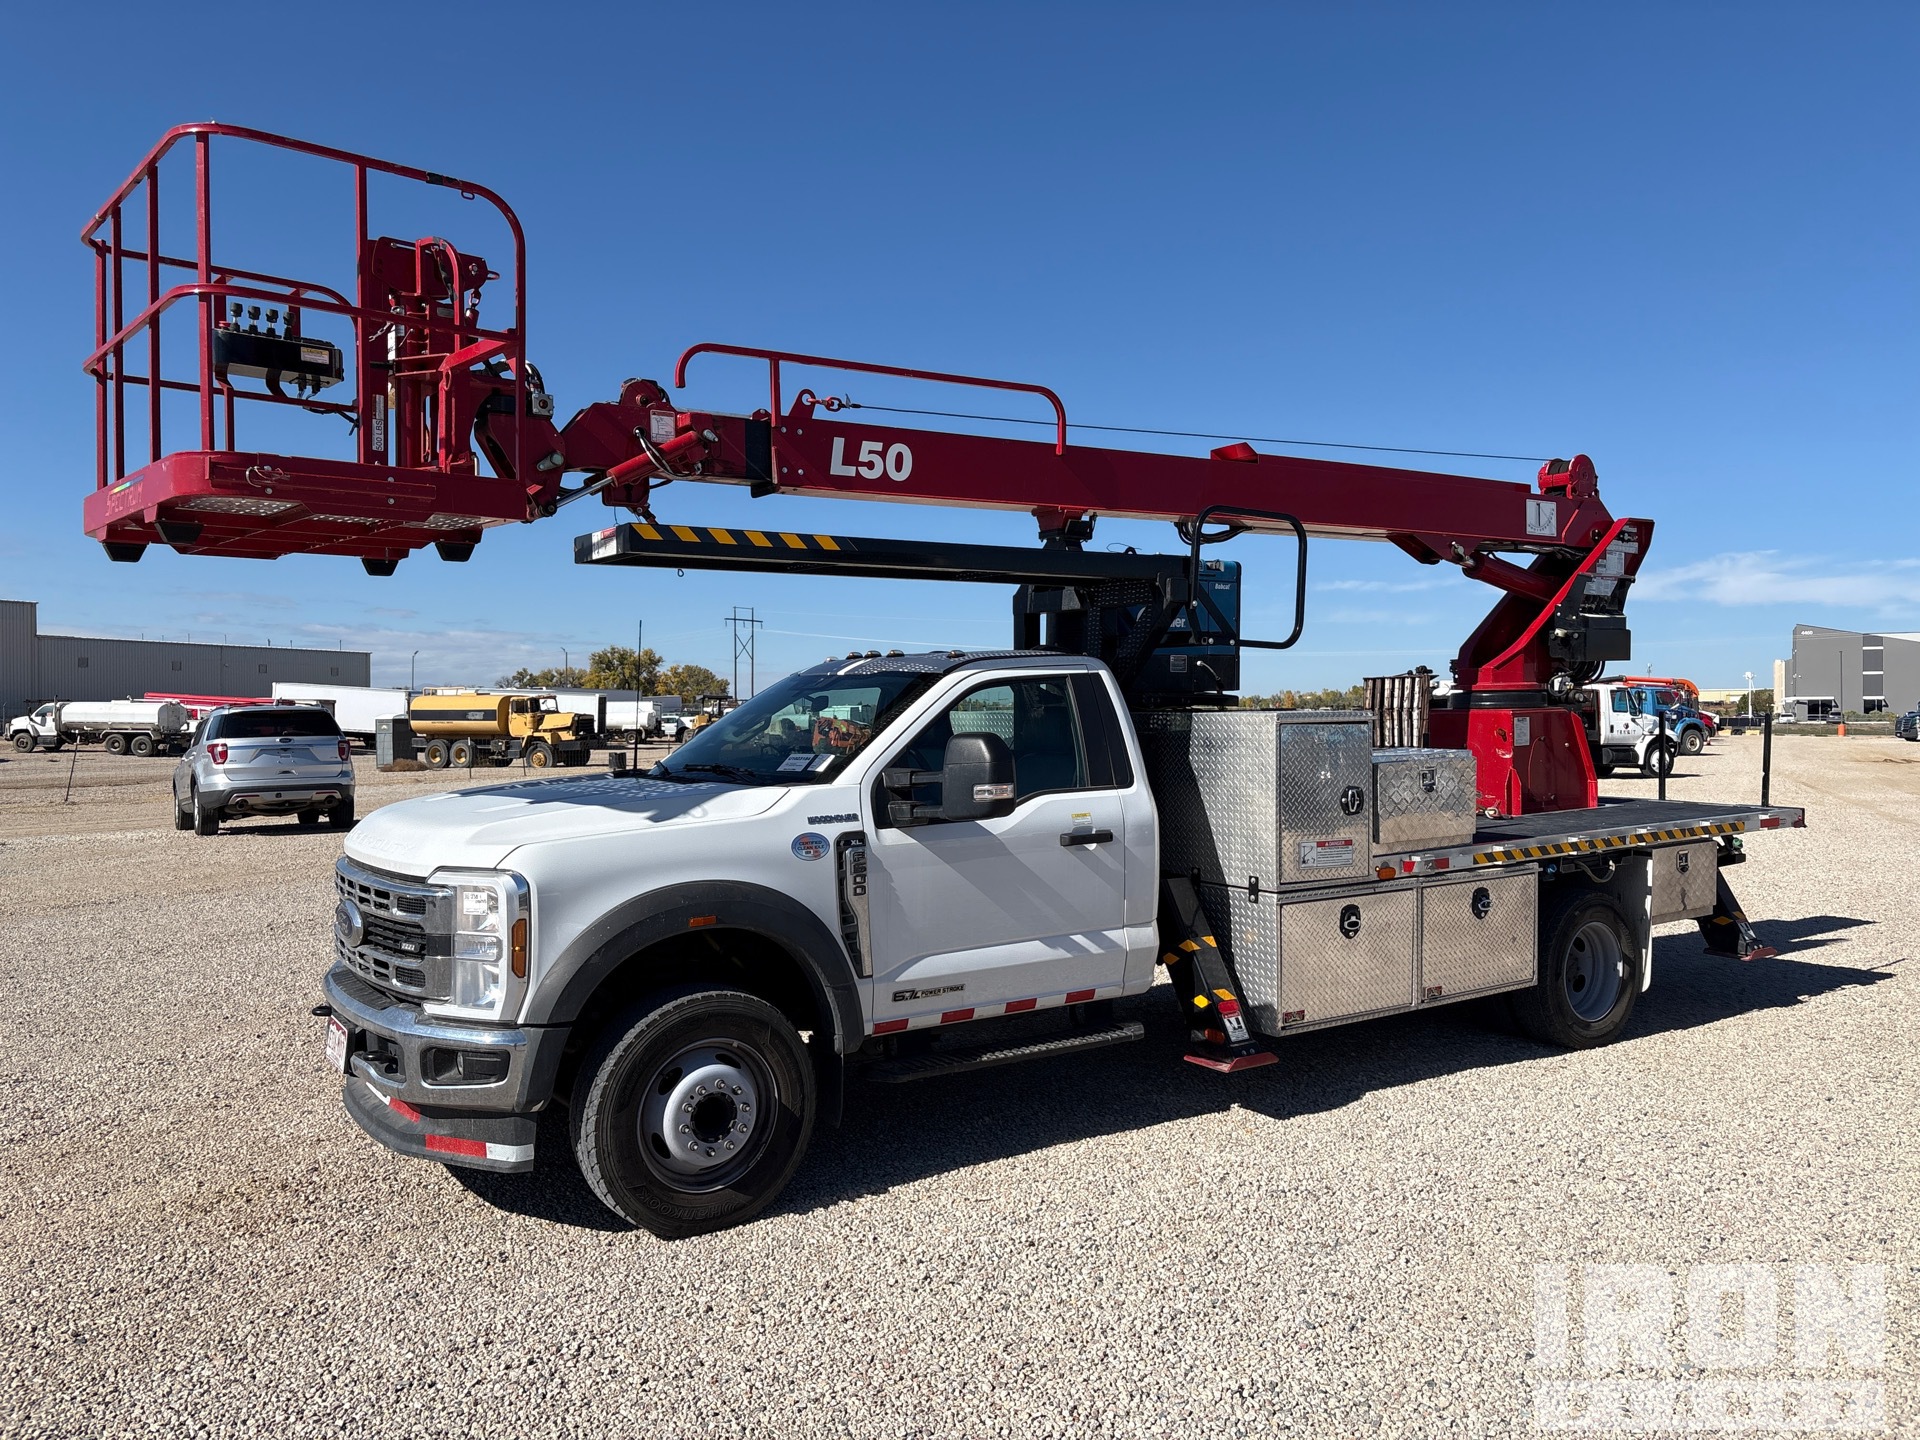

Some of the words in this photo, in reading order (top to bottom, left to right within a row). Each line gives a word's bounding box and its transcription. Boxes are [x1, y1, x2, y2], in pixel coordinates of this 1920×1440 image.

[375, 420, 383, 435] LBS
[375, 437, 383, 450] 500
[829, 436, 913, 482] L50
[892, 989, 920, 1002] 6.7L
[921, 988, 941, 997] POWER
[942, 984, 965, 993] STROKE
